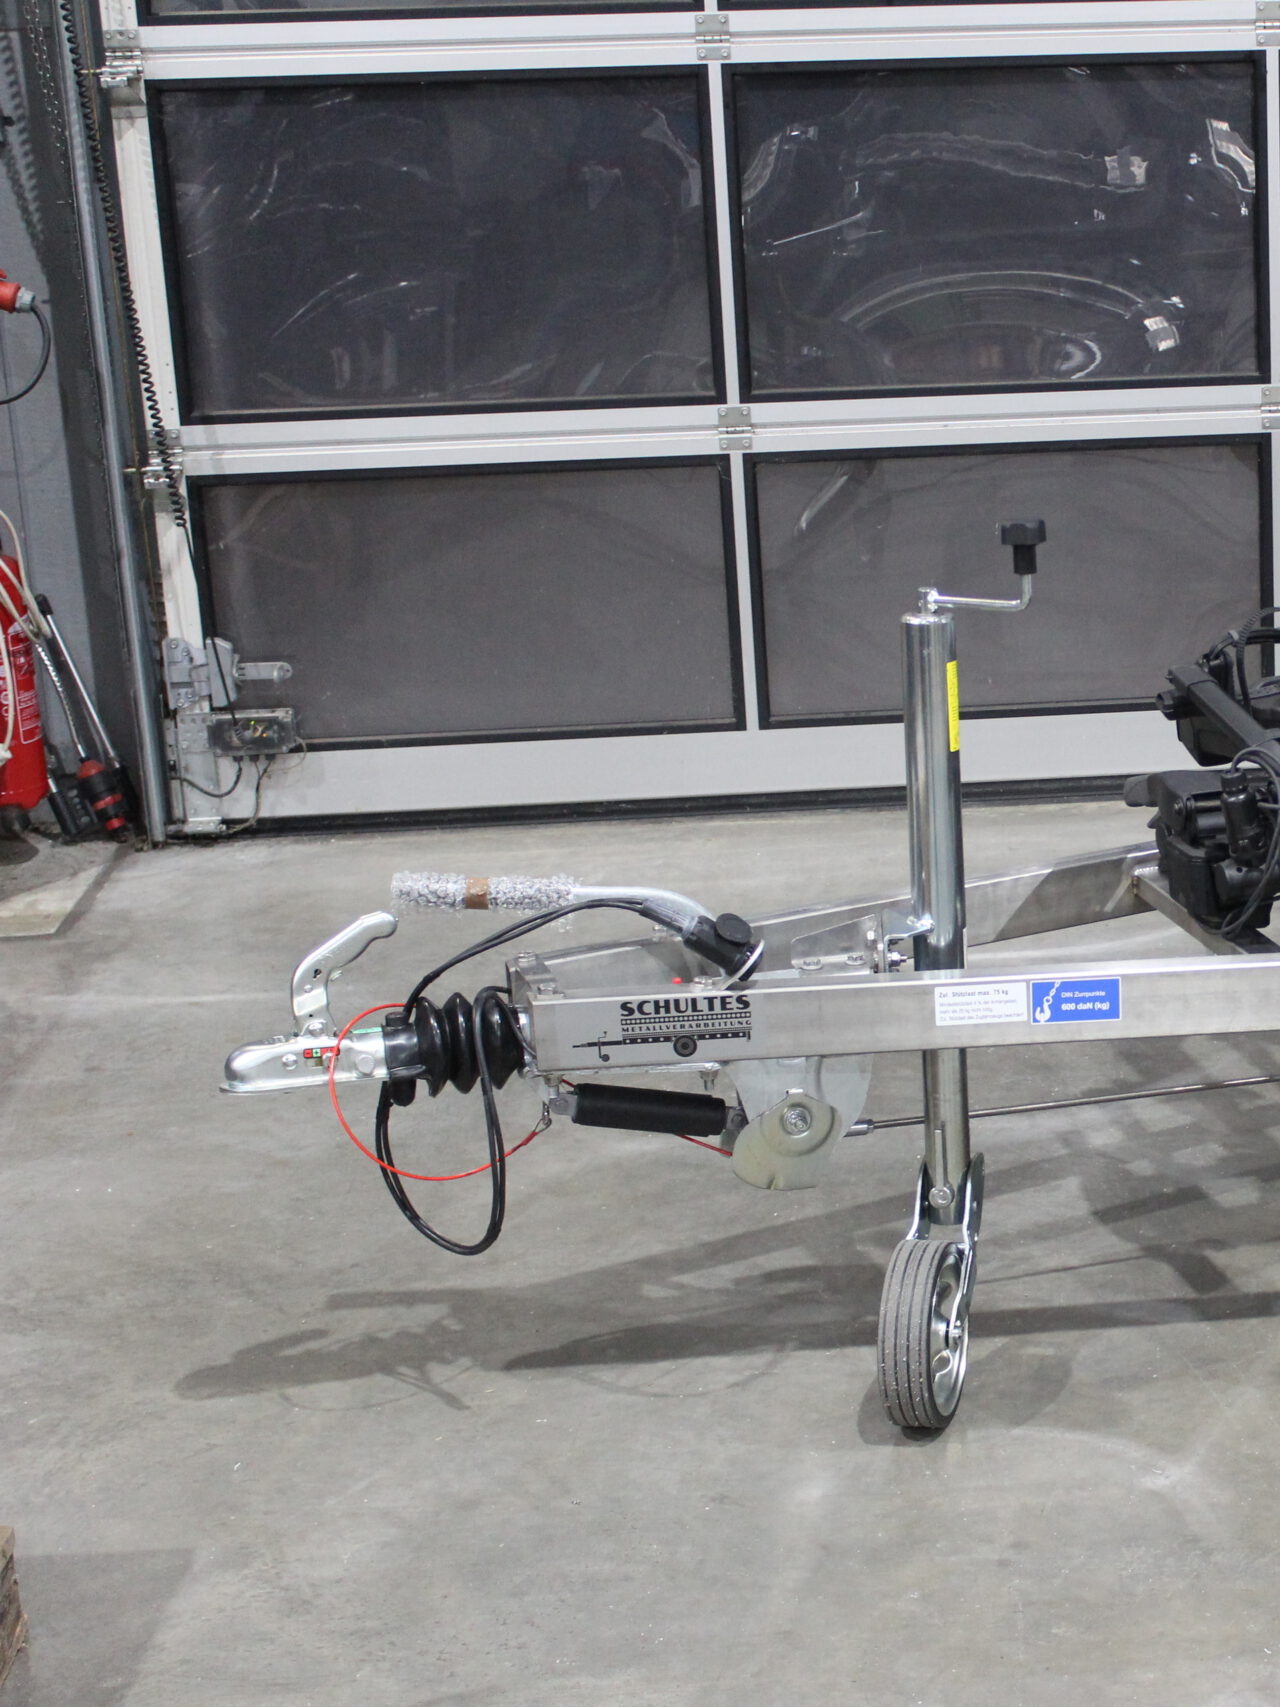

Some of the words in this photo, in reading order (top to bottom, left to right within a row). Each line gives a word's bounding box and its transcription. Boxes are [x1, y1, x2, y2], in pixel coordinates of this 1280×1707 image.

[620, 995, 751, 1017] SCHULTES
[1077, 1002, 1093, 1010] daN
[1094, 1001, 1110, 1011] (kg)
[621, 1020, 752, 1033] METALLVERARBEITUNG
